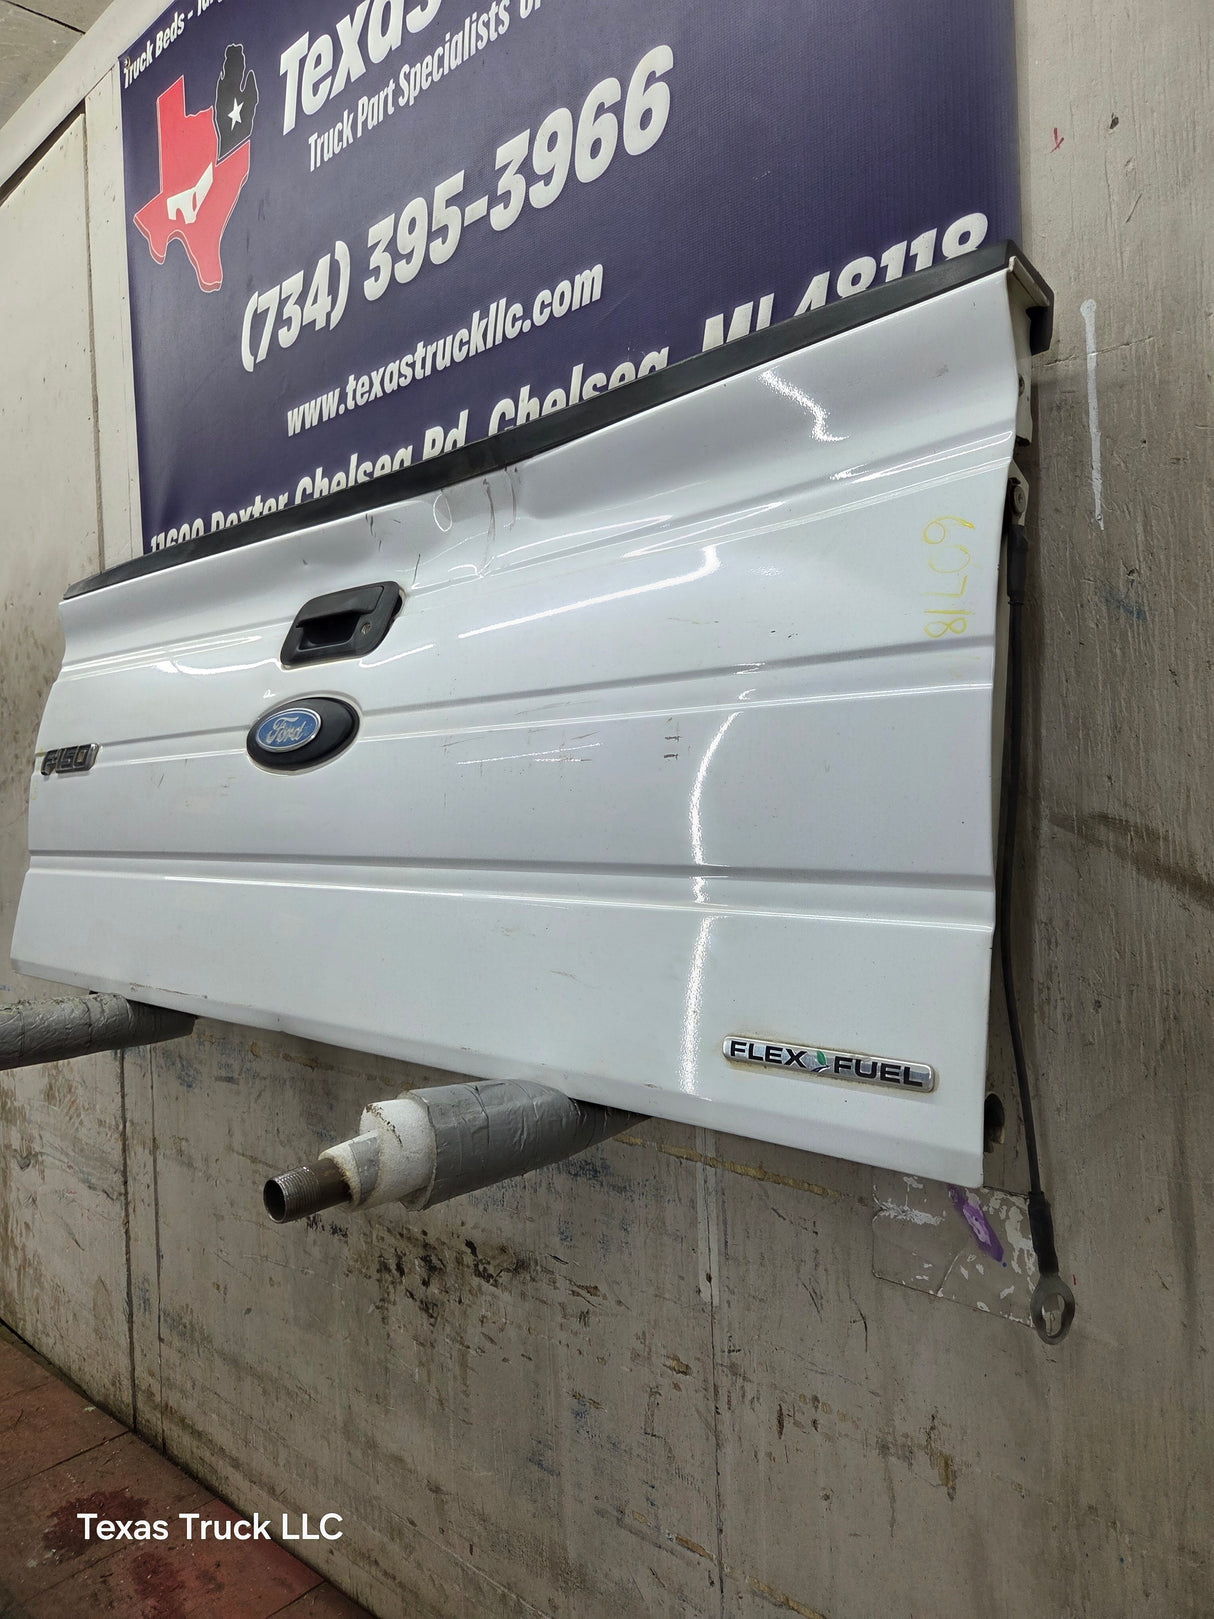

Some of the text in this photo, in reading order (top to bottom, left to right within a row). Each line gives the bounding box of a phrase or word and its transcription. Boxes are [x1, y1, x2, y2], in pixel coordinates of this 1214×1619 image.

[123, 40, 154, 89] Truck
[155, 11, 185, 58] Beds
[308, 109, 354, 172] Truck
[357, 78, 395, 138] Part
[398, 0, 510, 107] Specialists
[240, 44, 674, 372] (734) 395-3966
[286, 263, 604, 437] www.texastruckllc.com
[265, 716, 307, 744] Ford
[730, 1040, 923, 1087] FLEX FUEL
